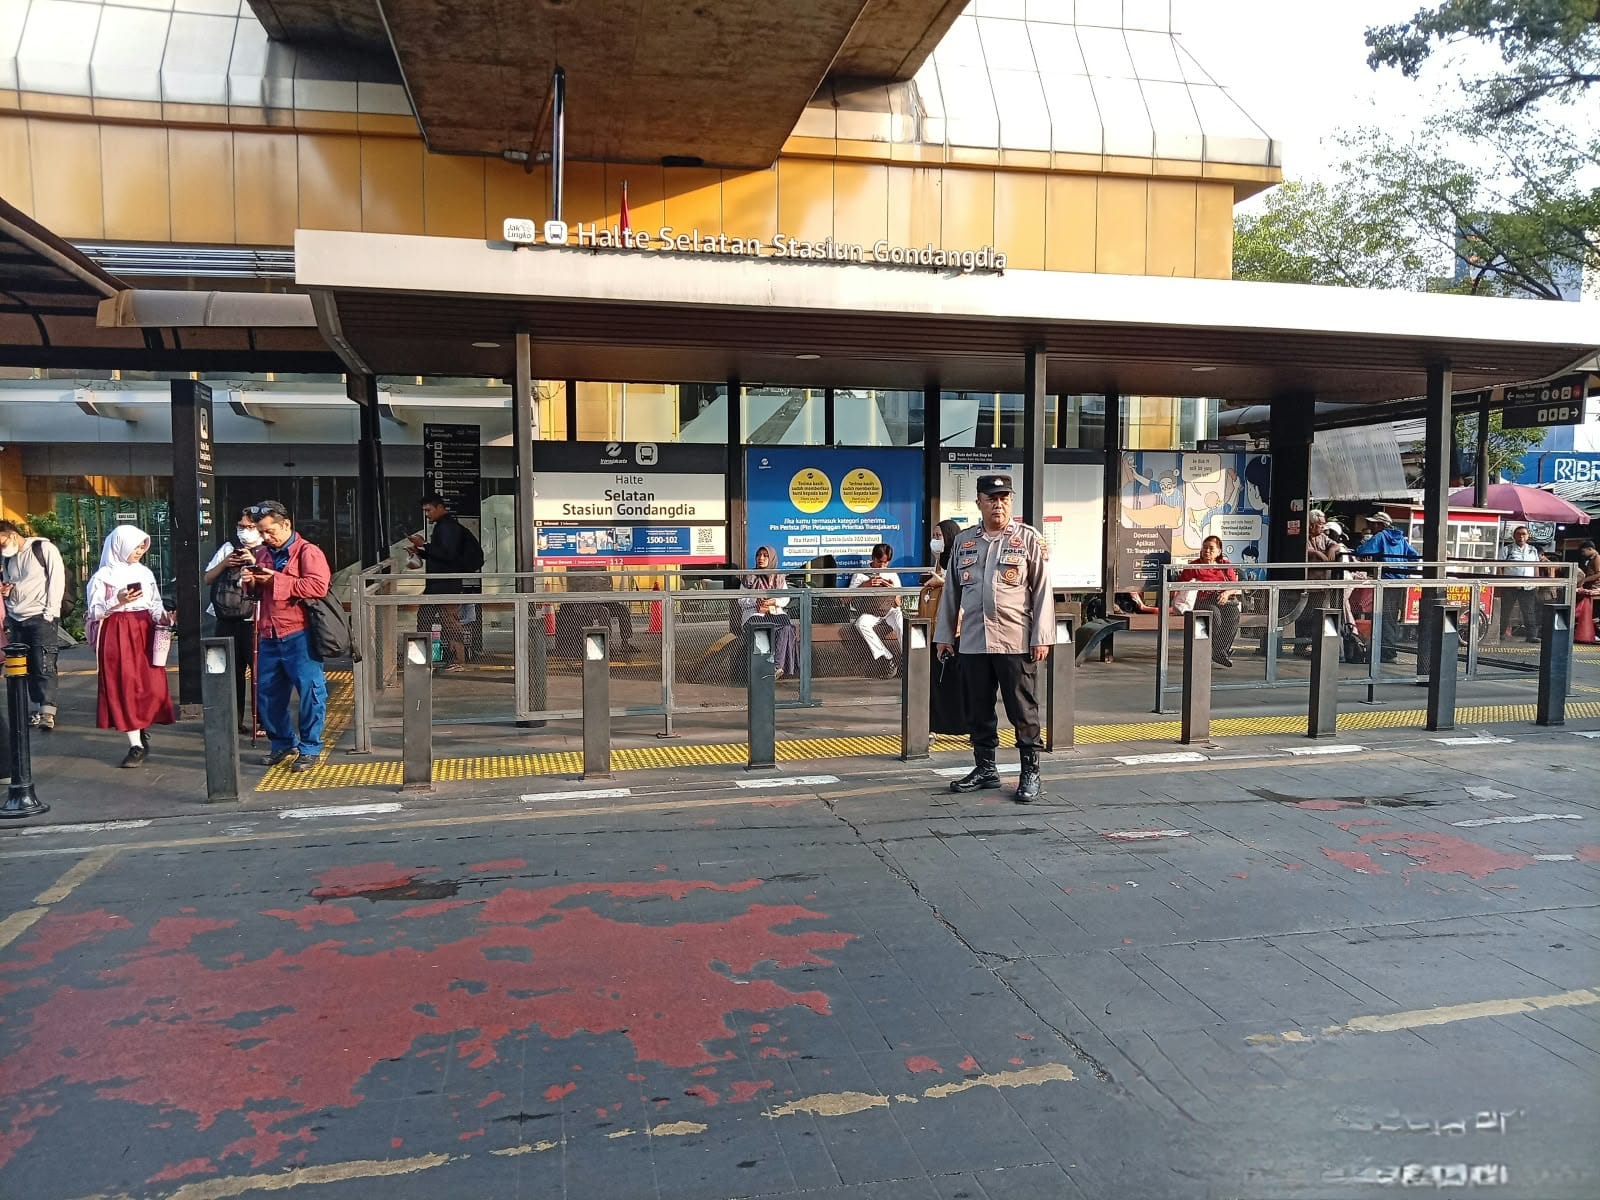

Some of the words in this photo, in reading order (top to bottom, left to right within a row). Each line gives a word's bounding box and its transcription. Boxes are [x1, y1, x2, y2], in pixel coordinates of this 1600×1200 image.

[507, 231, 532, 239] Lingko
[578, 222, 650, 249] Halte
[659, 226, 761, 255] Selatan
[772, 233, 864, 260] Stasiun
[873, 239, 1008, 272] Gondangdia
[615, 474, 644, 485] Halte
[604, 489, 656, 502] Selatan
[562, 503, 613, 516] Stasiun
[616, 503, 696, 519] Gondangdia
[811, 517, 837, 525] termasuk
[837, 517, 860, 526] kategori
[860, 518, 886, 526] penerima
[812, 524, 841, 532] Pelanggan
[1133, 531, 1159, 539] Download
[646, 536, 678, 544] 1500-102
